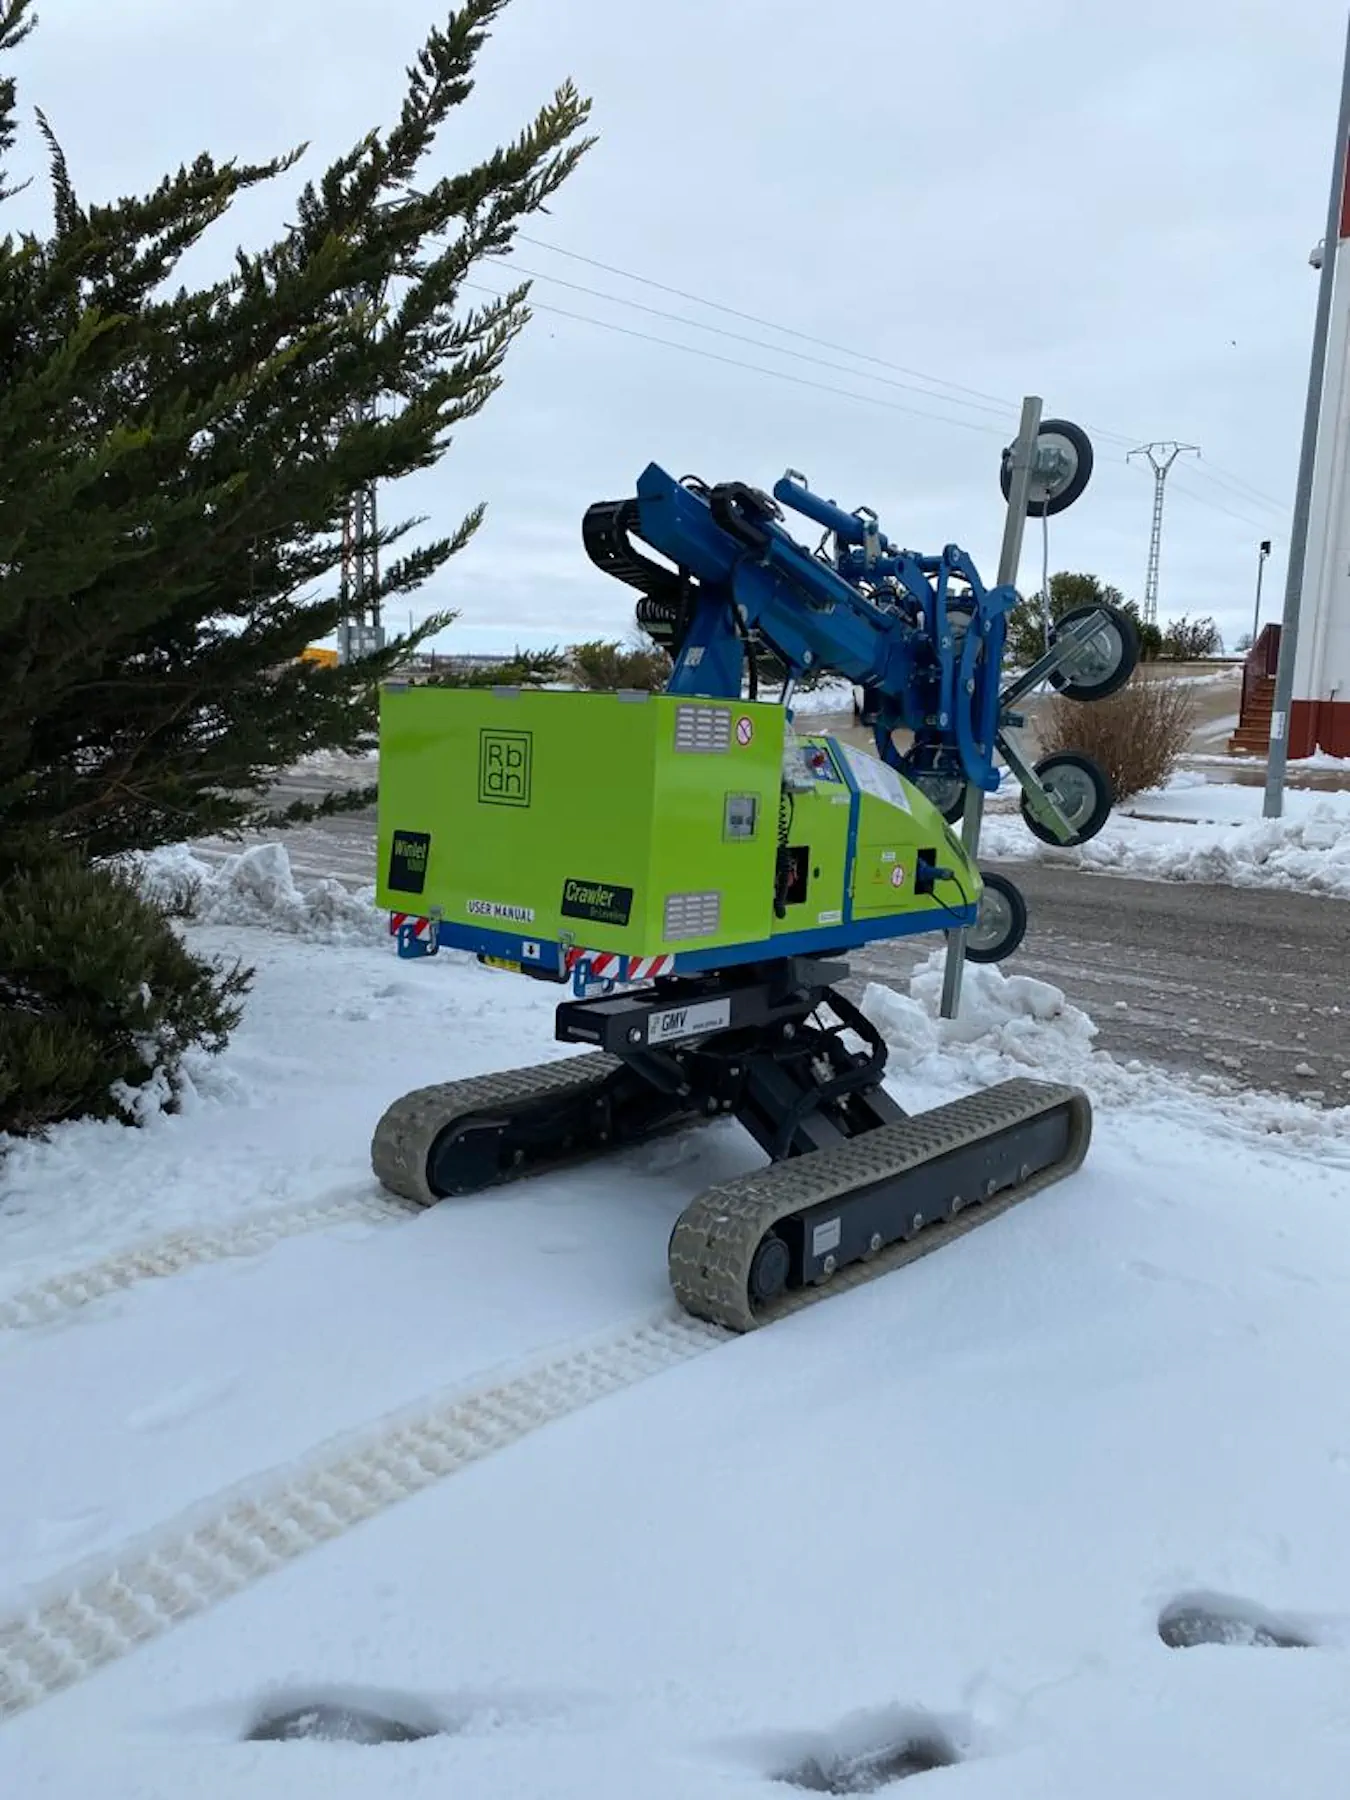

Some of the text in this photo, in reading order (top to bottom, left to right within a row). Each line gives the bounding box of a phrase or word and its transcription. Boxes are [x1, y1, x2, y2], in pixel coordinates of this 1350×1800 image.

[489, 744, 521, 767] Rb
[488, 767, 521, 793] dn
[565, 881, 615, 908] Crawler
[469, 900, 534, 922] USER MANUAL
[662, 1009, 688, 1031] GMV
